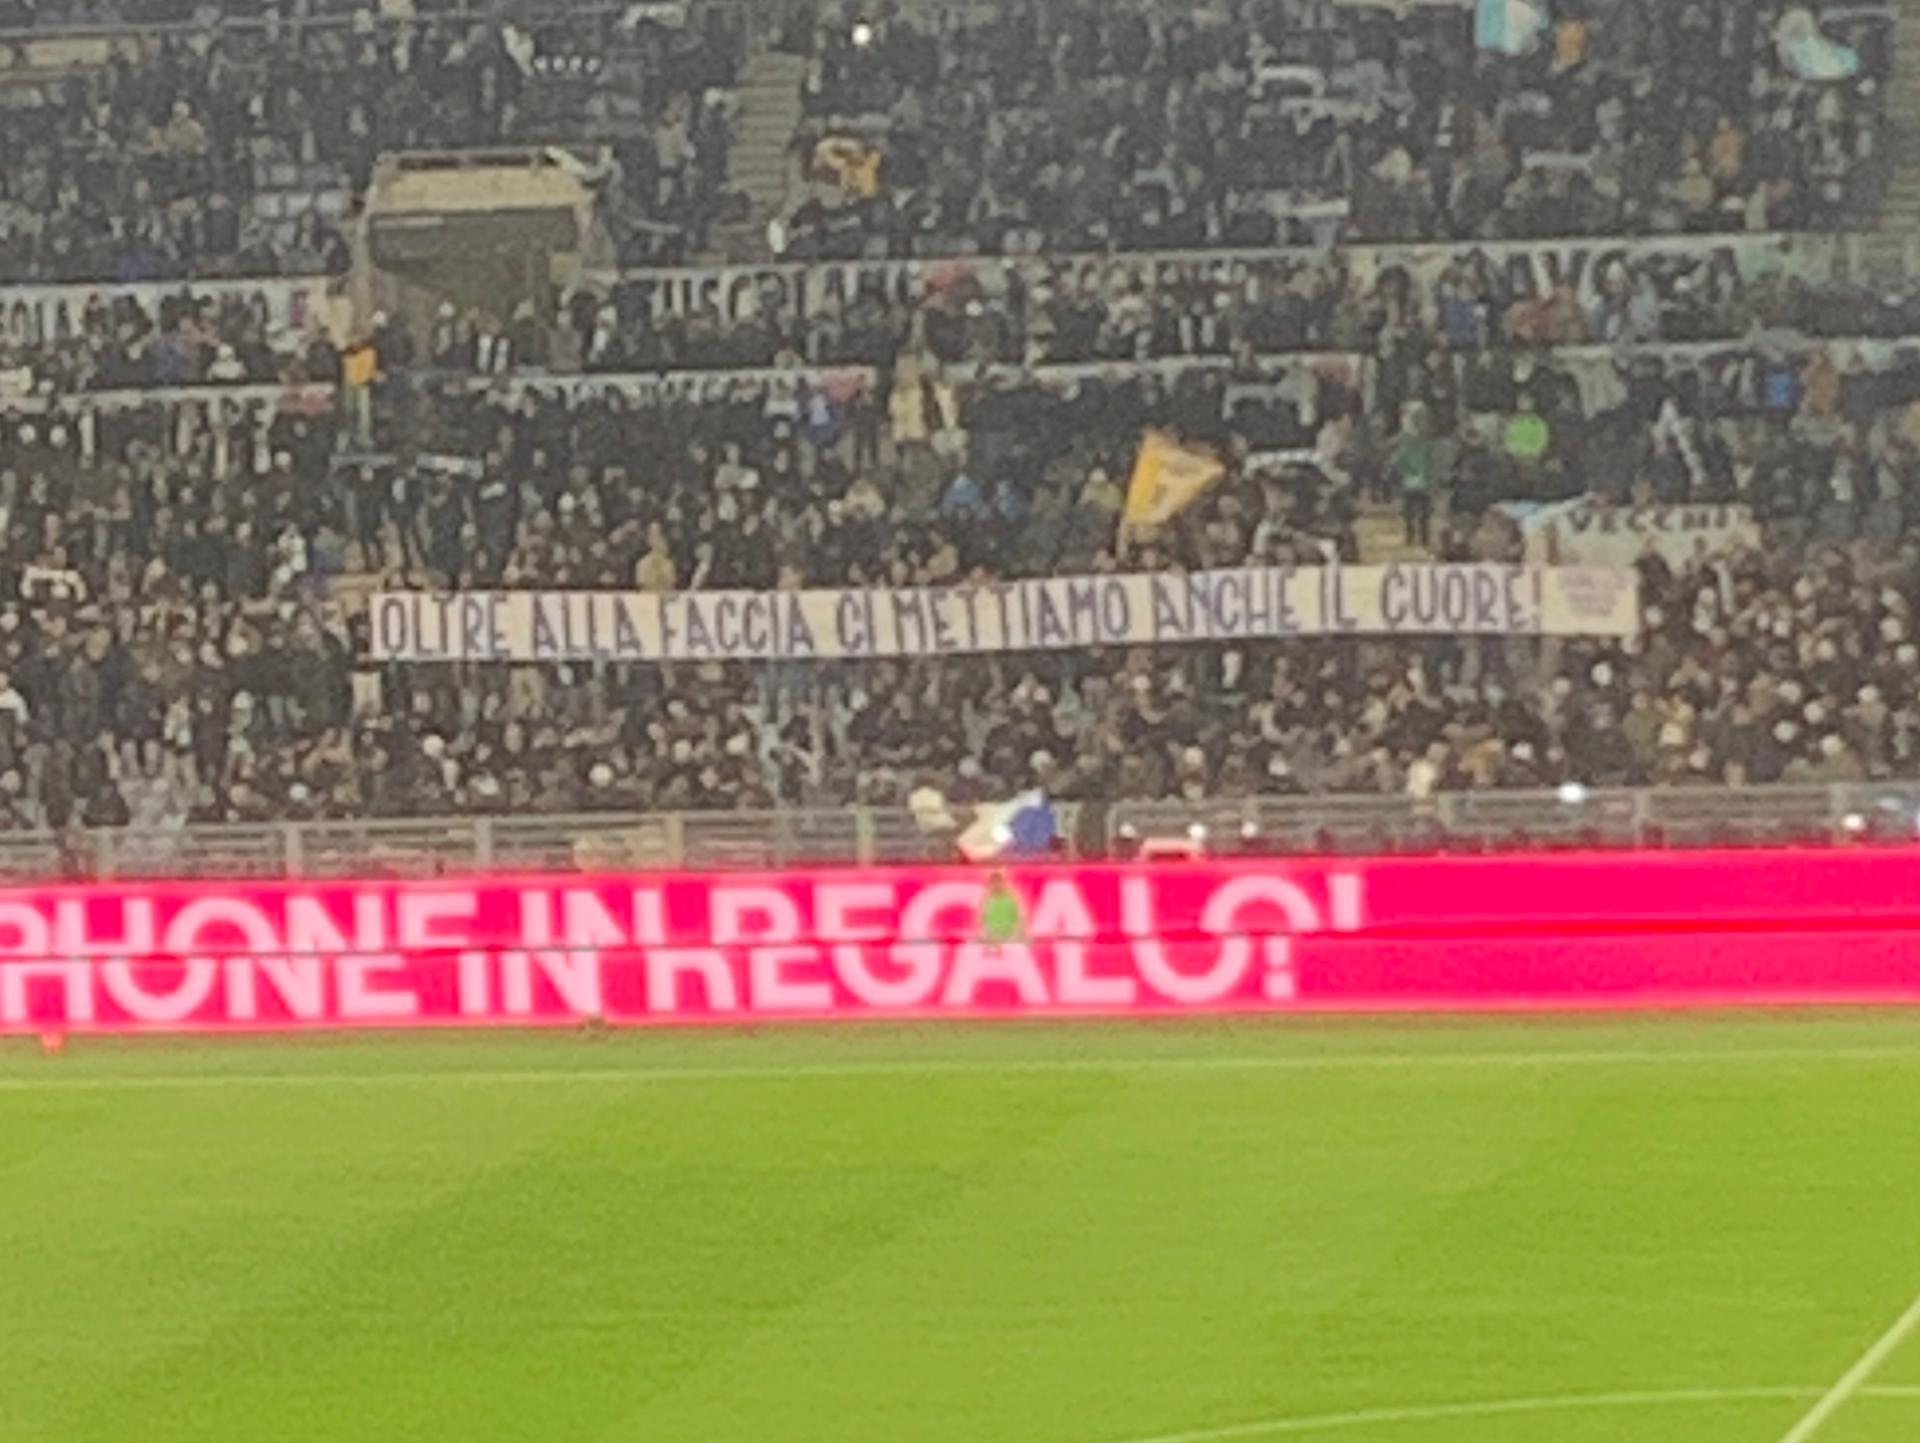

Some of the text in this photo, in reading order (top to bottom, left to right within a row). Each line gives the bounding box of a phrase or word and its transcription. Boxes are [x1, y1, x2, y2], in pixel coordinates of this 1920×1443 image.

[380, 596, 512, 656] OLTRE
[532, 595, 642, 656] ALLA
[660, 593, 815, 654] FACCIA
[836, 591, 877, 654] CI
[892, 579, 1131, 652] METTIAMO
[1151, 569, 1299, 641] ANCHE
[1320, 567, 1358, 629] IL
[1378, 565, 1542, 630] CUORE!
[458, 888, 667, 1014] IN
[646, 873, 1364, 1012] REGALO!
